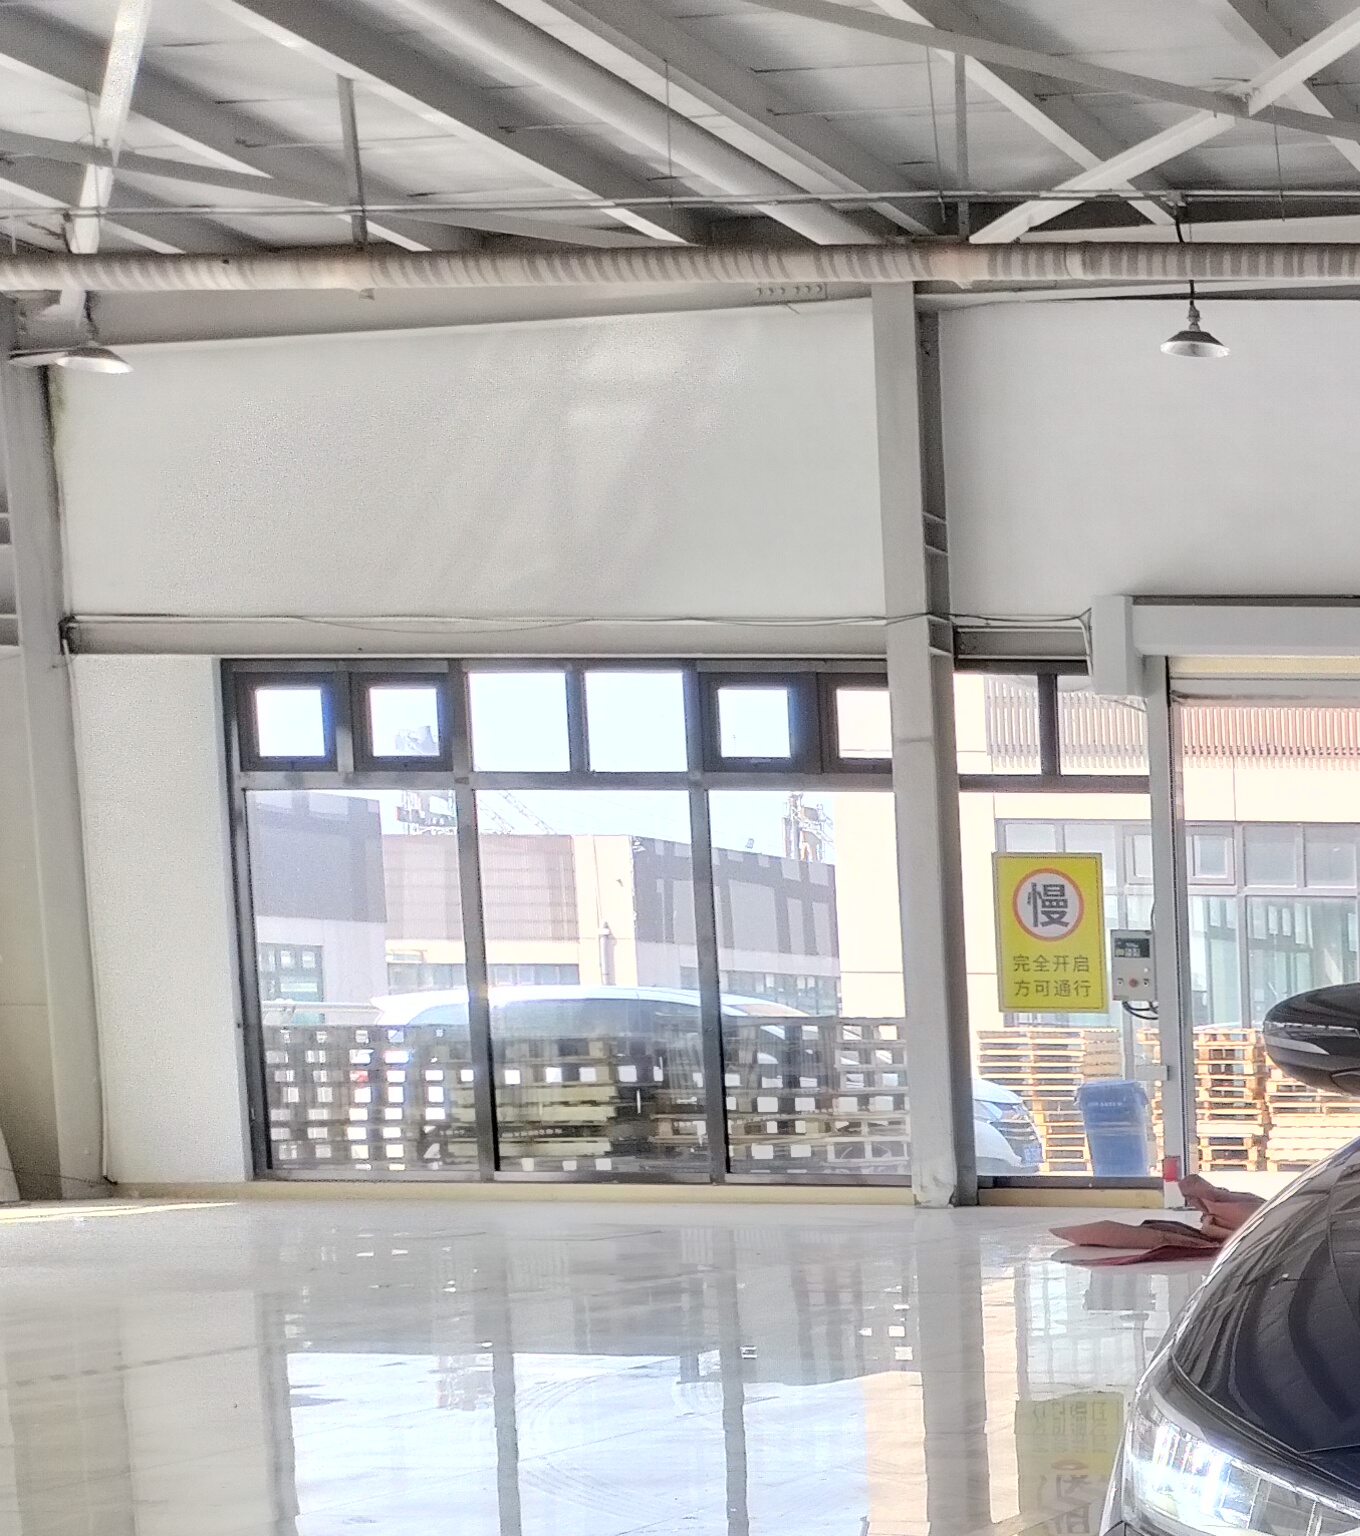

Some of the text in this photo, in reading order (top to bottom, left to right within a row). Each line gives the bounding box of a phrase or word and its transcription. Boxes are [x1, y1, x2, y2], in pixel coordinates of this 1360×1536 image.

[1027, 882, 1070, 928] 慢
[1012, 954, 1090, 973] 完全开启
[1013, 979, 1092, 998] 方可通行
